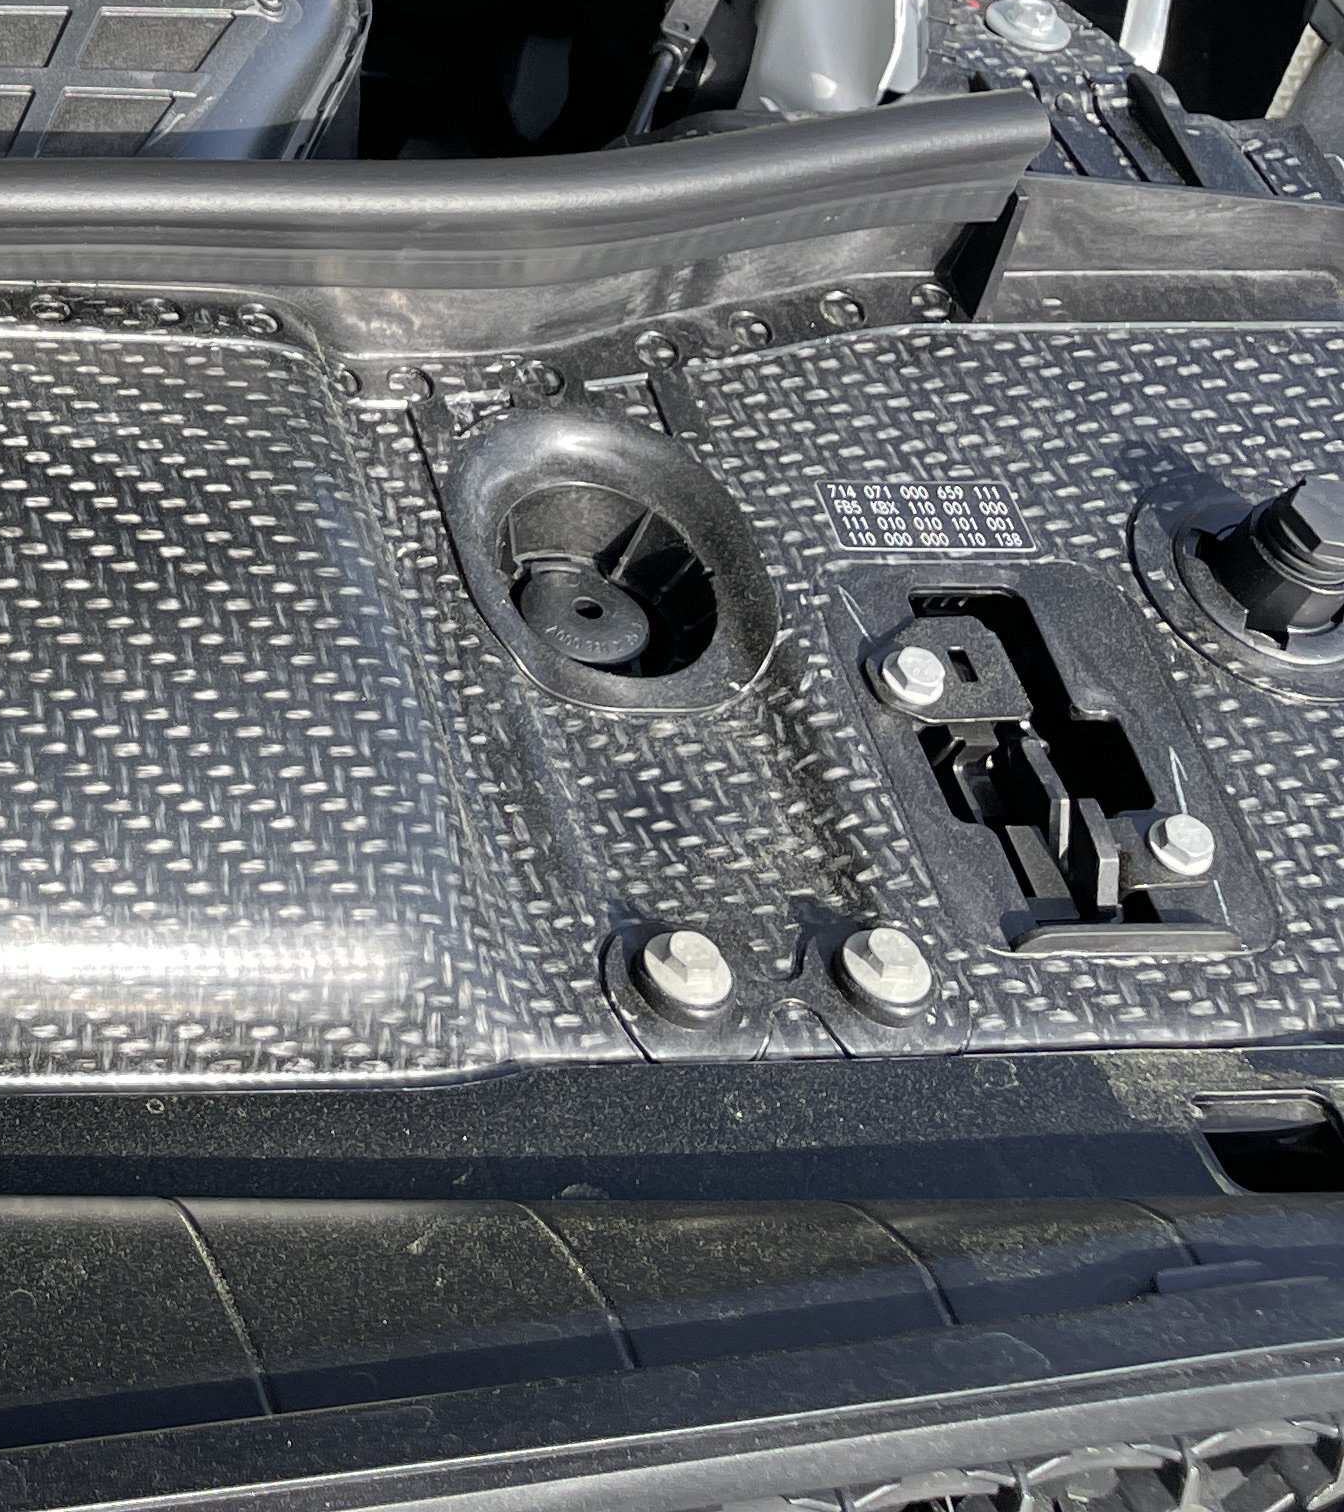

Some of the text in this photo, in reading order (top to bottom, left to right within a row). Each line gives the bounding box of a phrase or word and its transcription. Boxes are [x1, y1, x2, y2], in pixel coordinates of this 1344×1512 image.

[827, 484, 1000, 500] 714 071 000 659 111
[870, 501, 900, 515] KBX
[908, 501, 936, 515] 110
[943, 501, 971, 516] 001
[979, 501, 1009, 516] 000
[841, 516, 1014, 531] 111 010 010 101 001
[848, 531, 1023, 547] 110 000 000 110 138
